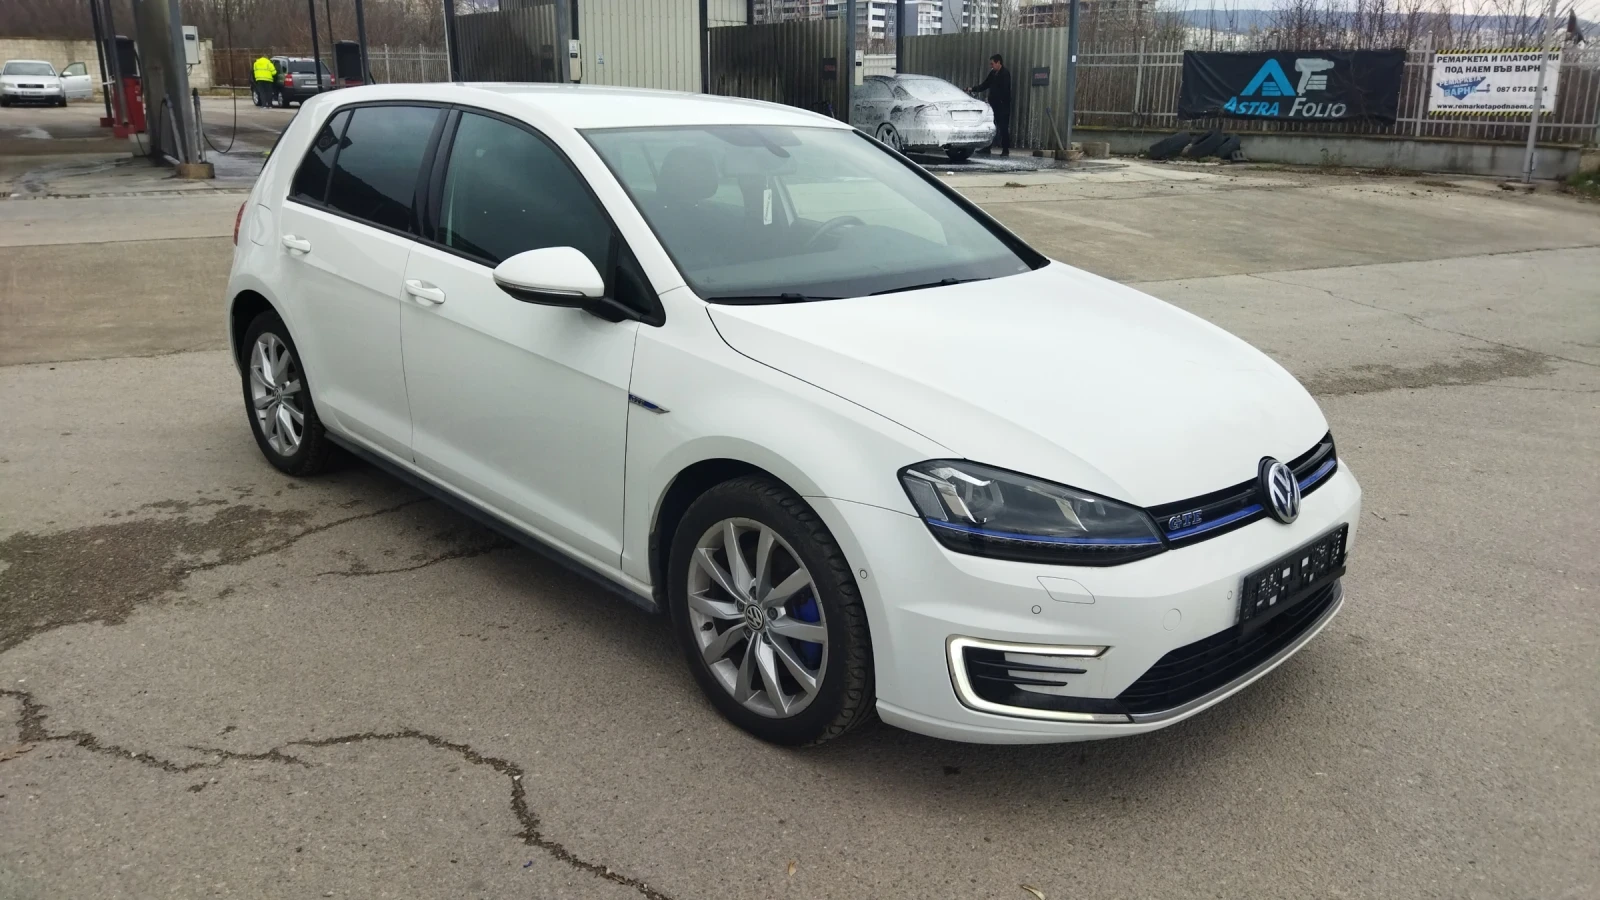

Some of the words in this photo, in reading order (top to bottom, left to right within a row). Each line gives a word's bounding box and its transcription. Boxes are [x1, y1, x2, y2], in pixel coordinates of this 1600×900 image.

[1437, 55, 1488, 63] РЕМАРКЕТА
[1444, 66, 1463, 74] ПОД
[1493, 65, 1513, 73] ВЪВ
[1444, 86, 1477, 97] ВАРНА
[1224, 97, 1279, 115] ASTRA
[1289, 98, 1346, 117] FOLIO
[1168, 510, 1202, 530] GTE
